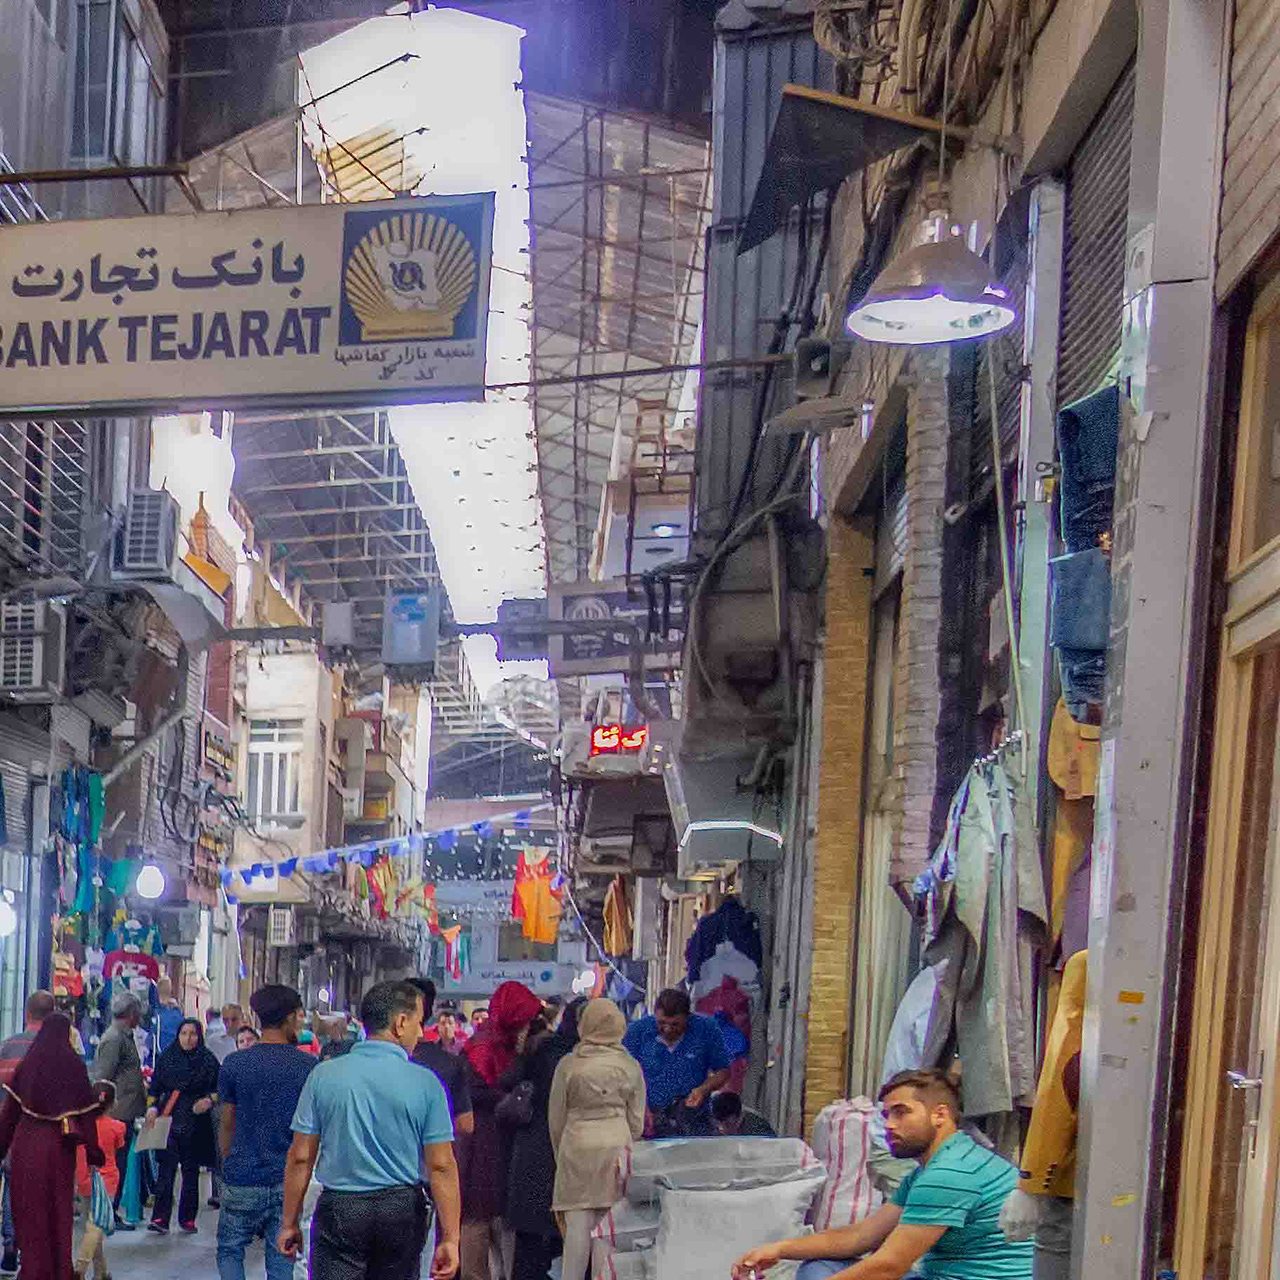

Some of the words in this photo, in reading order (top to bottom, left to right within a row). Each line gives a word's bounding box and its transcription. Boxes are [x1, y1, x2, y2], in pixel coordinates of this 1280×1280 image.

[12, 246, 161, 306] تجارت
[171, 238, 305, 300] بانک
[118, 305, 332, 362] TEJARAT
[391, 345, 428, 367] بازار
[433, 344, 476, 365] شعبه
